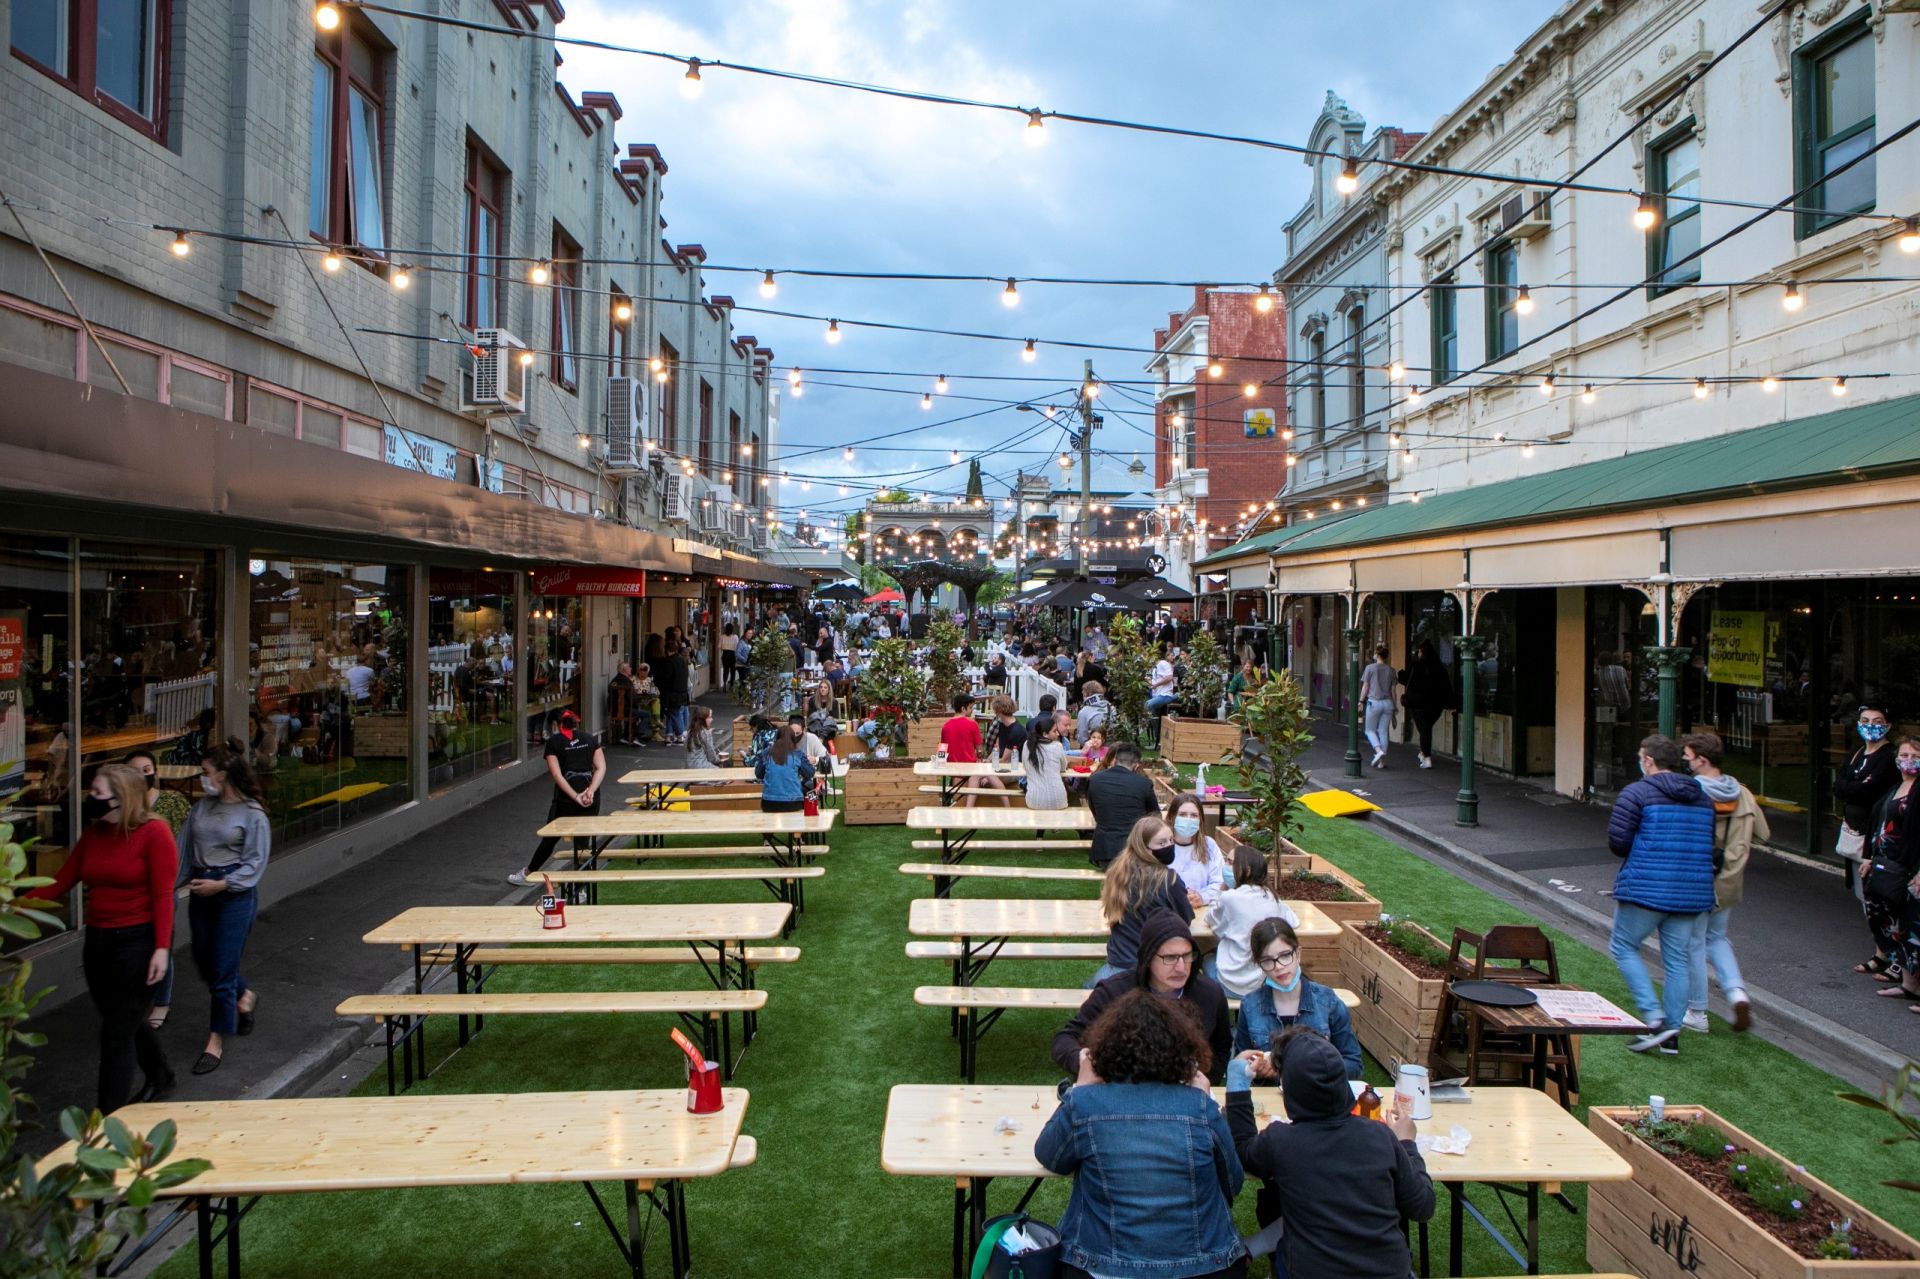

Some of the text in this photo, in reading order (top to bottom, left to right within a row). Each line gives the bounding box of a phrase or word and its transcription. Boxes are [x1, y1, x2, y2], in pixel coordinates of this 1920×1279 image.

[537, 569, 571, 593] Grill'd
[576, 582, 640, 592] HEALTHY BURGERS
[1713, 615, 1742, 628] Lease
[1711, 648, 1760, 665] Opportunity
[544, 898, 554, 908] 22
